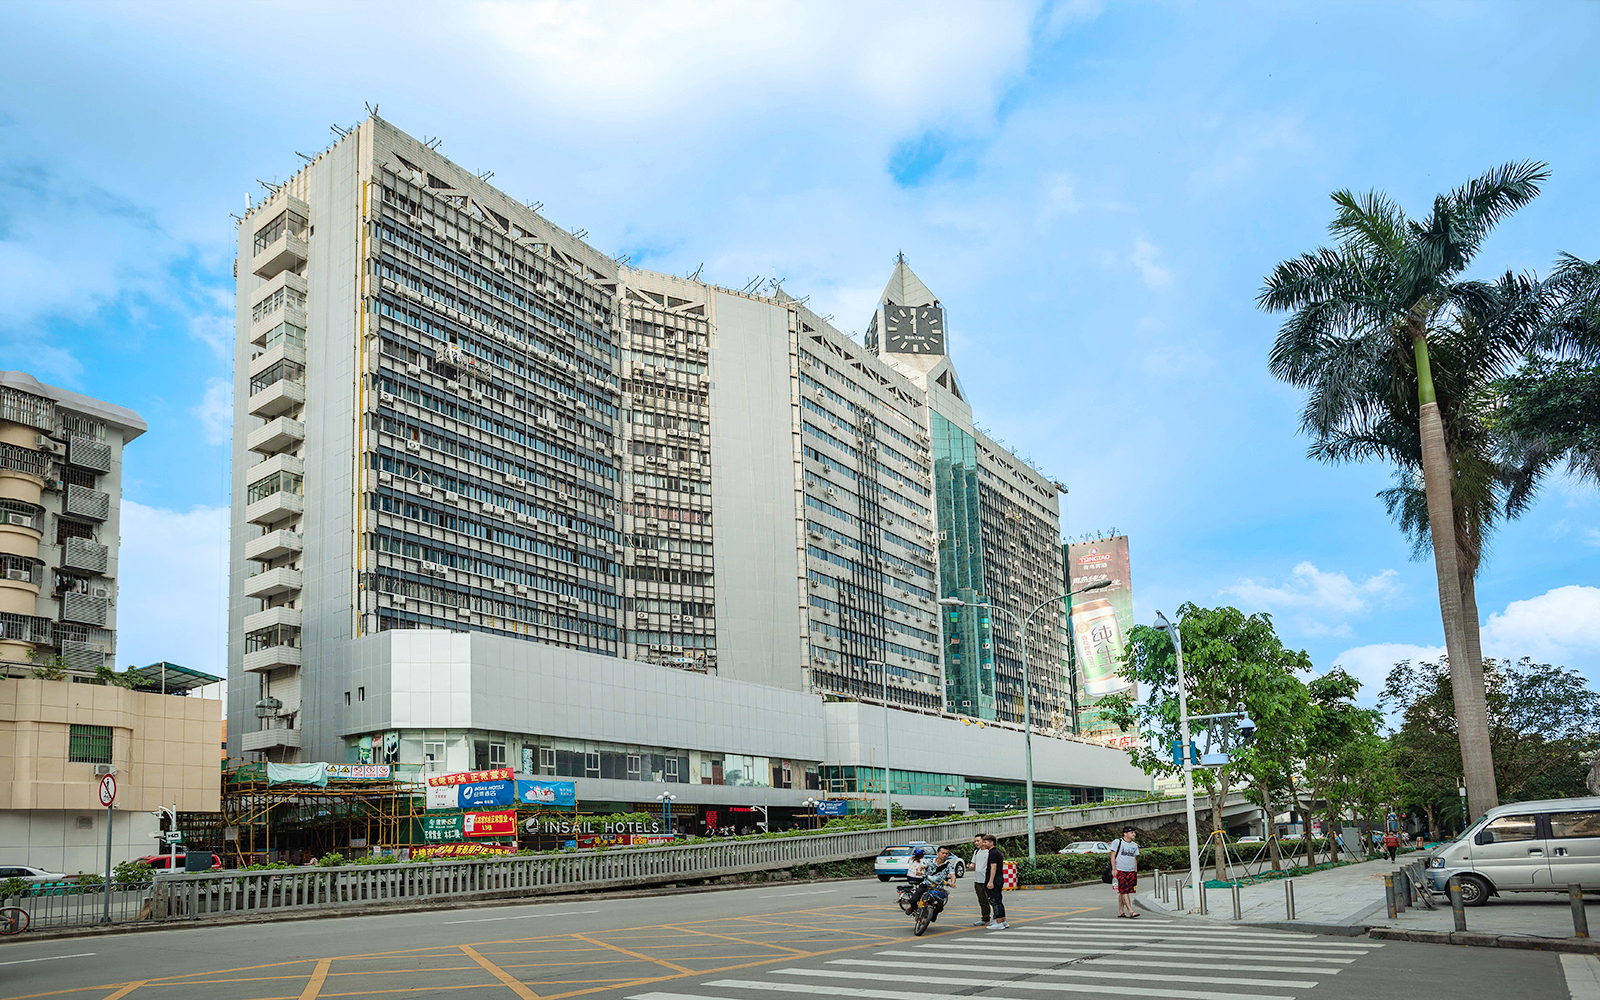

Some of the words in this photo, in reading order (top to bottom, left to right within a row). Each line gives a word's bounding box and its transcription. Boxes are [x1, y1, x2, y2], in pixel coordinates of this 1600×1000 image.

[1079, 554, 1110, 563] TSINGTAO
[1092, 625, 1119, 667] 纯生
[470, 770, 510, 782] 正常营业
[545, 822, 595, 834] INSAIL
[605, 822, 659, 834] HOTELS
